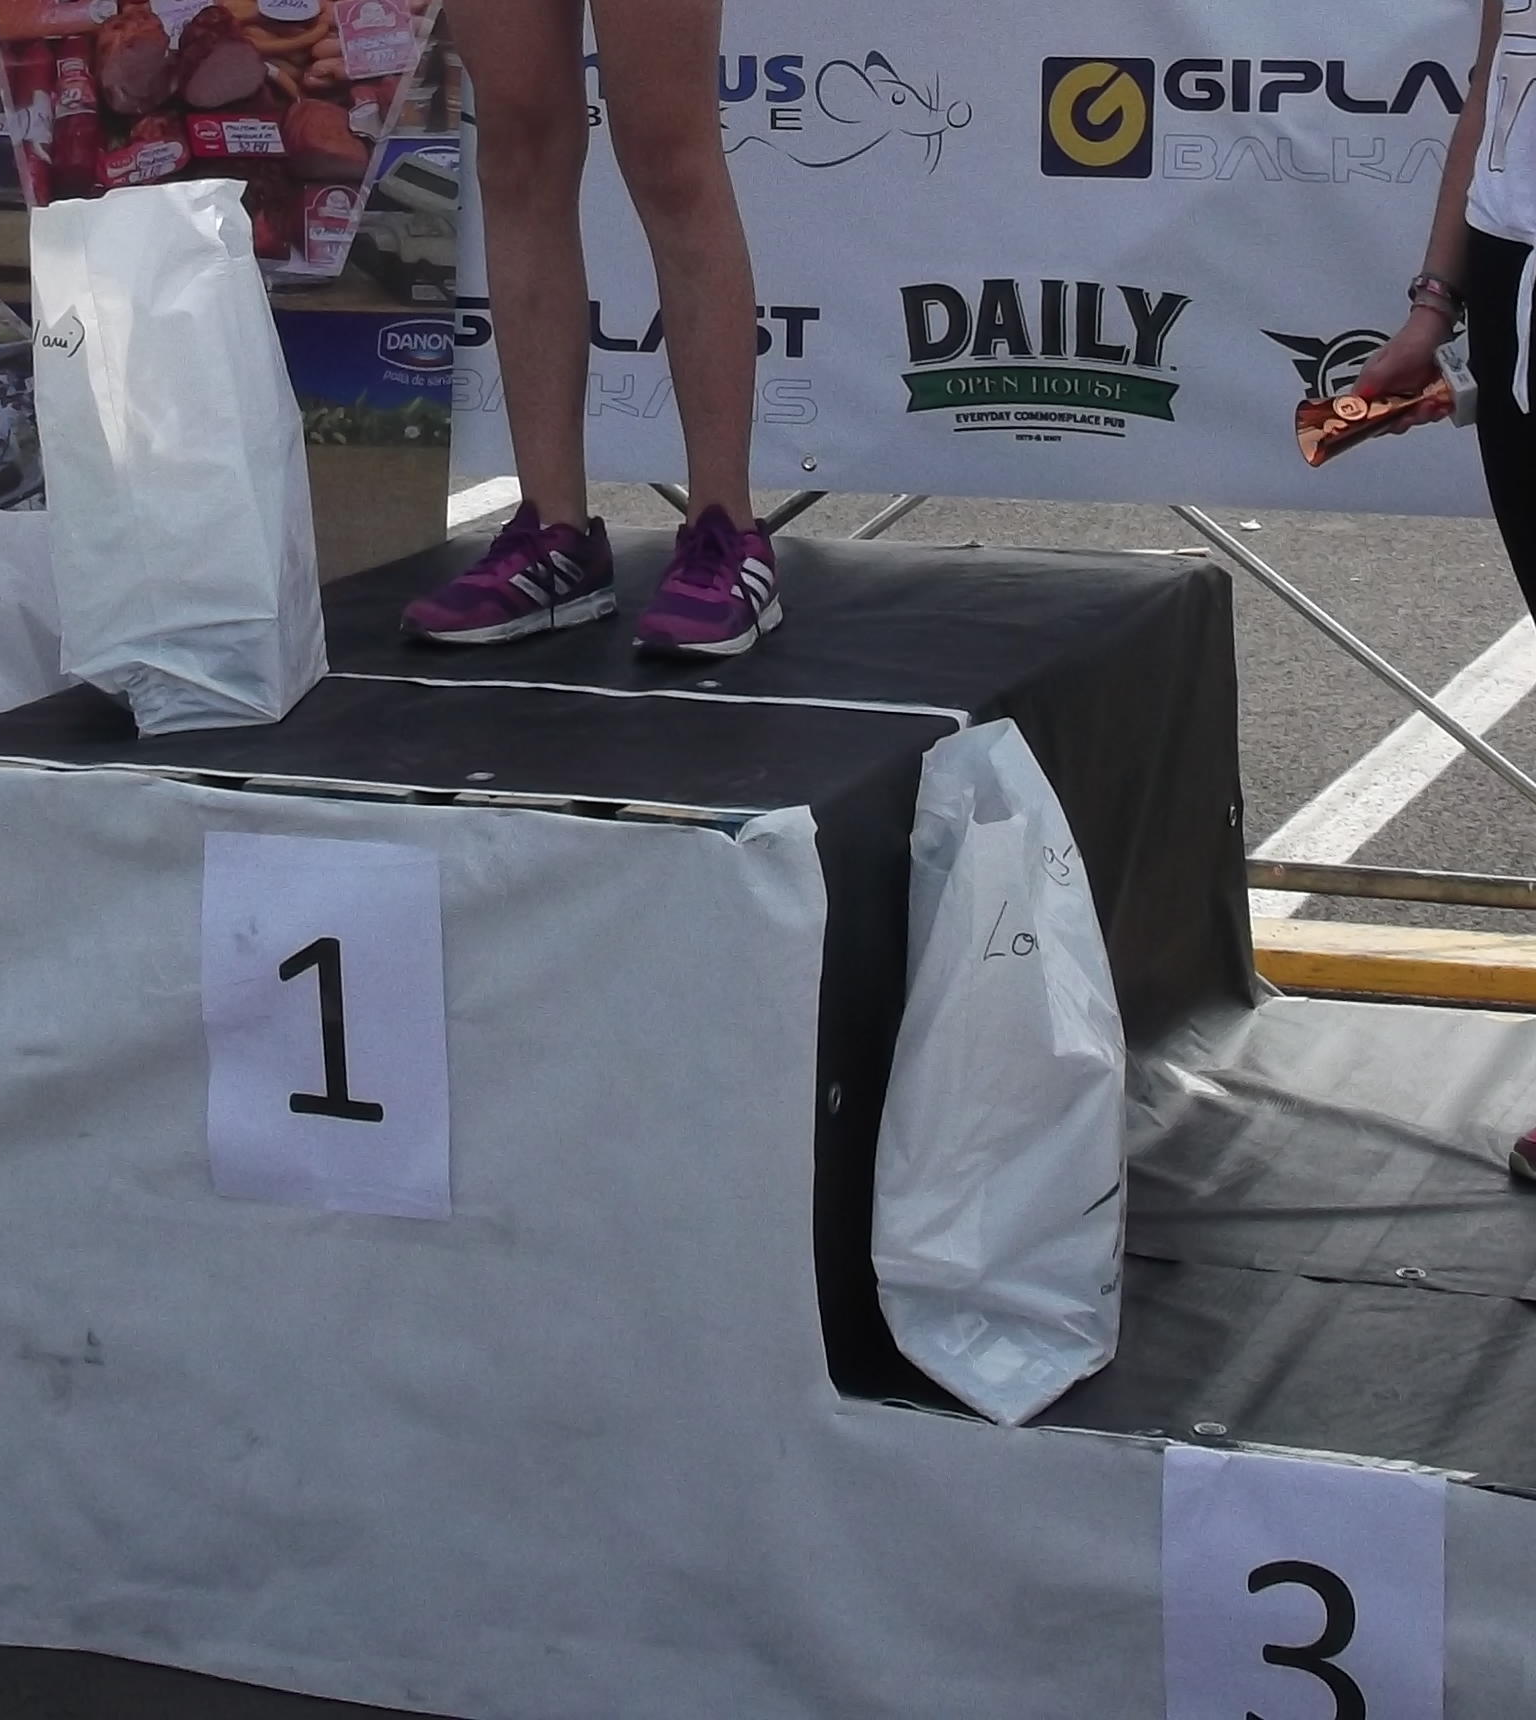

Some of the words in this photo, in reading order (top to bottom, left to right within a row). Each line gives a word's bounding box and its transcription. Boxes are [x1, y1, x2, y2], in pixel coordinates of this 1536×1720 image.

[899, 278, 1195, 370] DAILY
[945, 376, 1020, 396] OPEN
[1030, 376, 1131, 401] HOUSE
[955, 411, 1012, 424] EVERYDAY
[1103, 416, 1126, 429] PUB
[278, 937, 384, 1123] 1
[1245, 1559, 1368, 1720] 3
